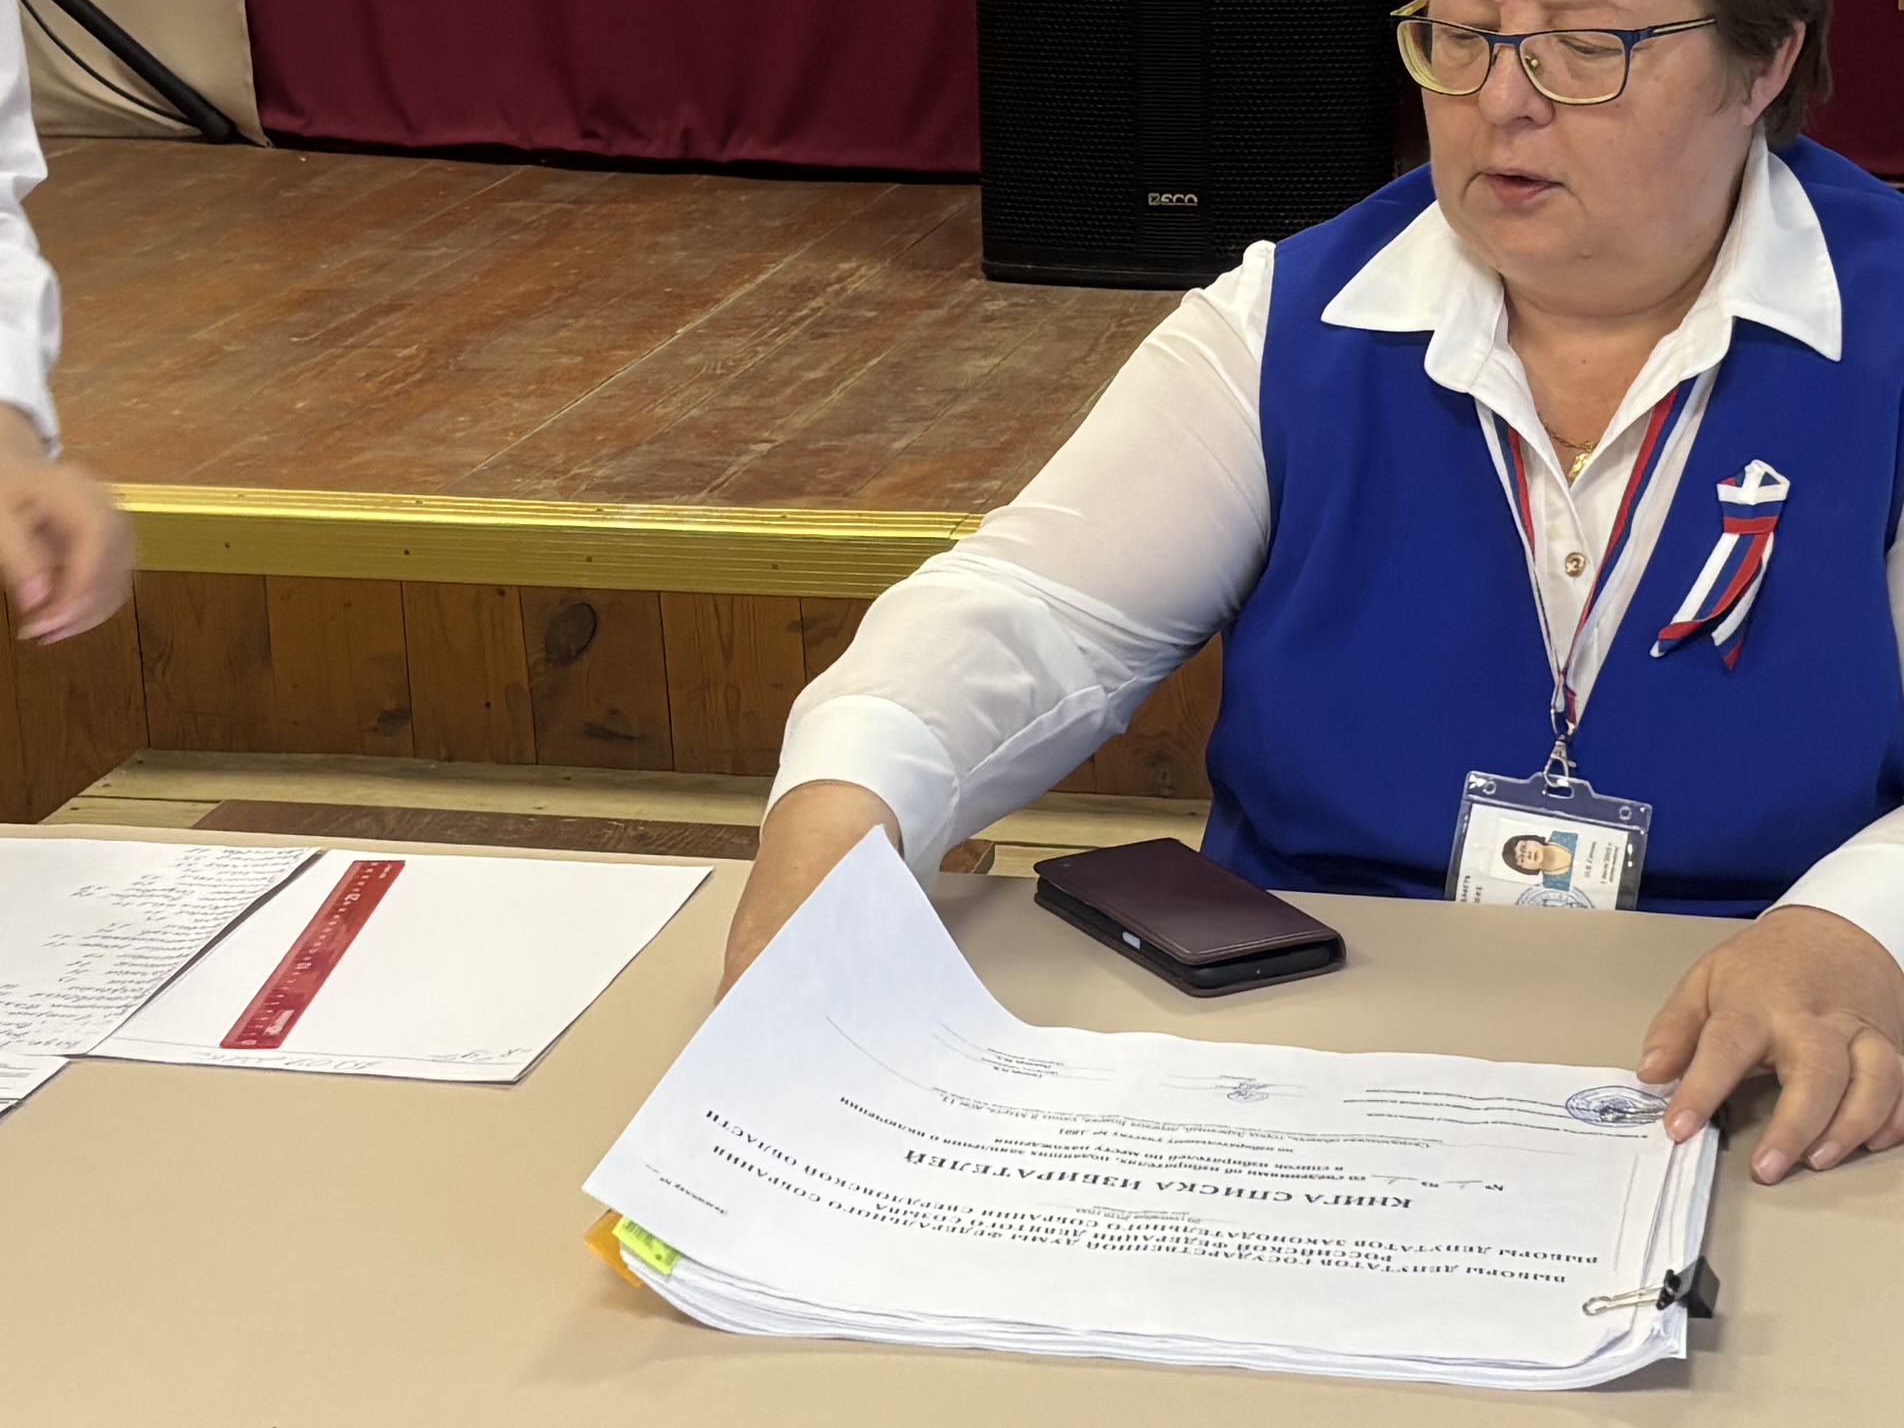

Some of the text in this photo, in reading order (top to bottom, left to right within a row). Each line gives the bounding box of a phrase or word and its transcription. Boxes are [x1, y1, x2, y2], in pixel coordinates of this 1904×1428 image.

[706, 1110, 797, 1167] ОБЛАСТИ
[804, 1165, 974, 1214] СВЕРДЛОВСКОЙ
[903, 1149, 1414, 1210] КНИГА СПИСКА ИЗБИРАТЕЛЕЙ
[828, 1200, 1002, 1239] ФЕДЕРАЛЬНОГО
[876, 1203, 1392, 1262] РОССИЙСКОЙ ФЕДЕРАЦИИ ДЕВЯТОГО СОЗЫВА
[1011, 1233, 1080, 1247] ДУМЫ
[1107, 1222, 1346, 1246] ЗАКОНОДАТЕЛЬНОГО
[1087, 1241, 1311, 1266] ГОСУДАРСТВЕННОЙ
[1354, 1240, 1492, 1255] ДЕПУТАТОВ
[1498, 1249, 1598, 1265] ВЫБОРЫ
[1320, 1258, 1459, 1274] ДЕПУТАТОВ
[1466, 1266, 1566, 1284] ВЫБОРЫ
